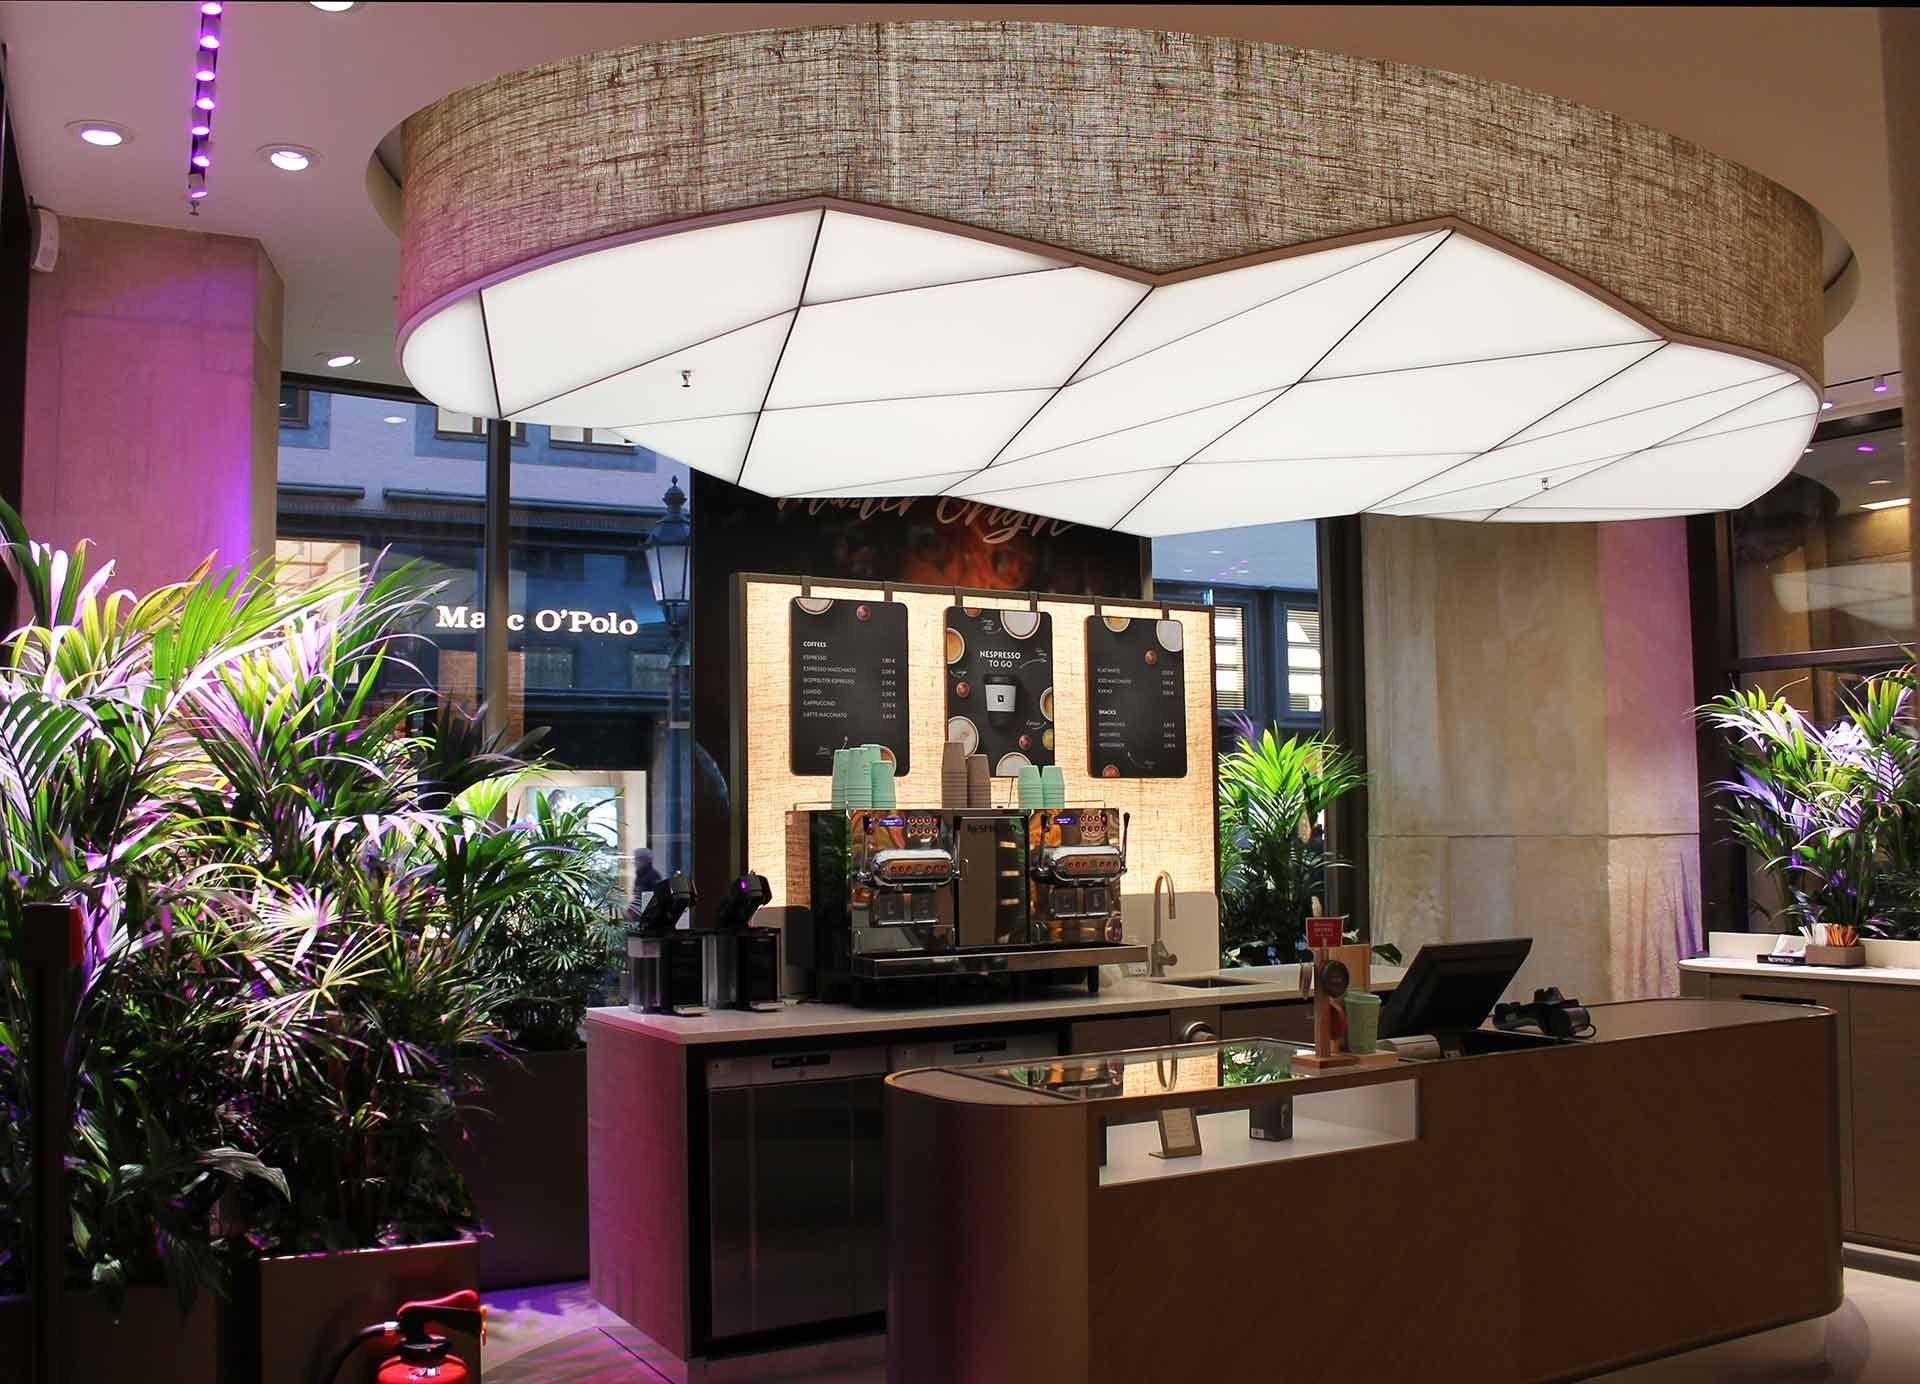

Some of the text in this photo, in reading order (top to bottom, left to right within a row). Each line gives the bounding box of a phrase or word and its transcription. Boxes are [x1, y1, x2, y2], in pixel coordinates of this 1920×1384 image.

[435, 605, 639, 635] Mac O'Polo
[980, 651, 1021, 659] NESPRESSO
[1001, 660, 1012, 668] GO
